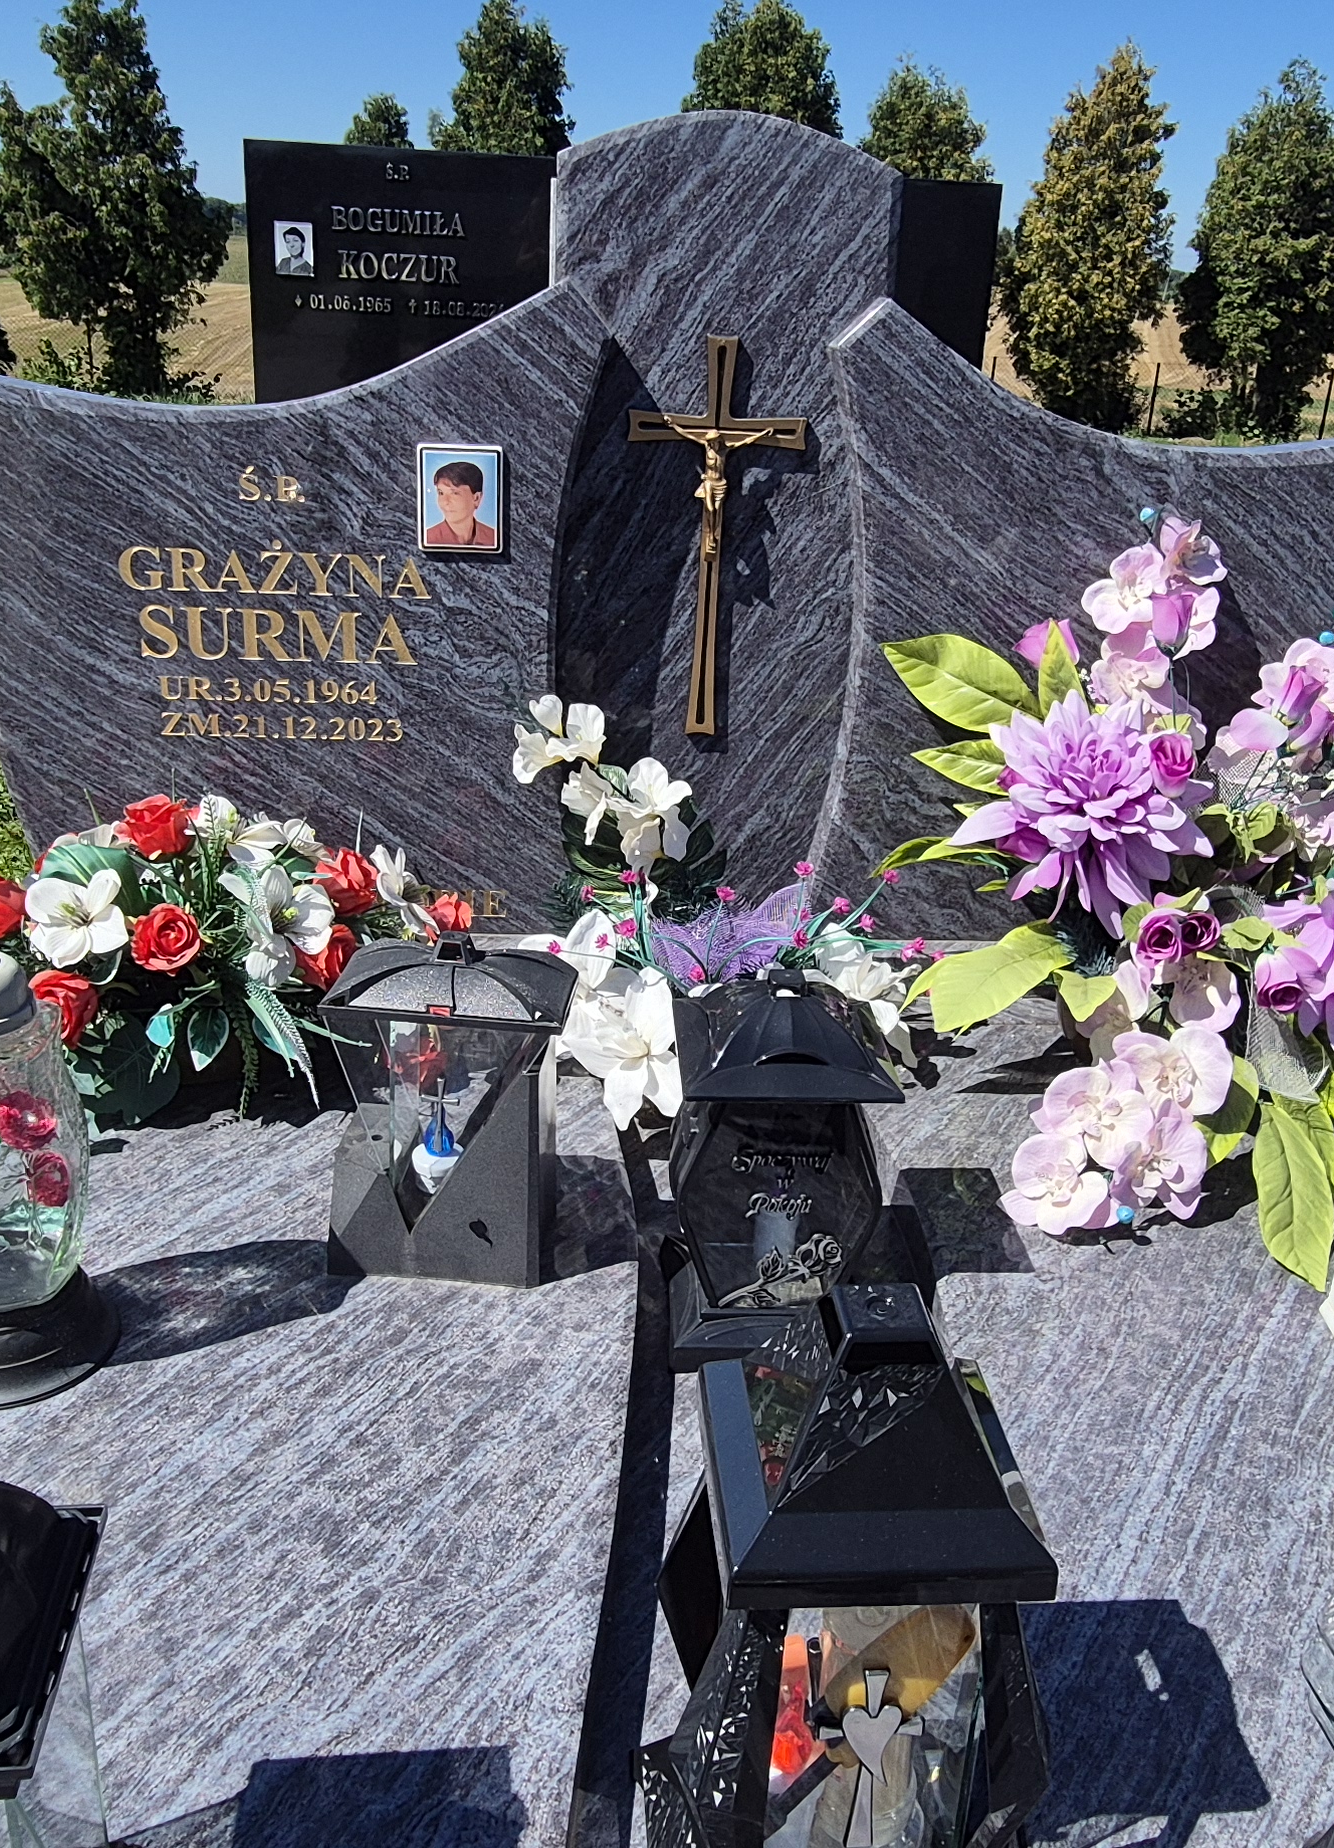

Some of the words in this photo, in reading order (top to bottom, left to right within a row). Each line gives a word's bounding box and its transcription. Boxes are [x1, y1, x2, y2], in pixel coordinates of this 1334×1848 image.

[385, 162, 410, 180] Ś.P.
[330, 205, 465, 237] BOGUMIŁA
[338, 249, 460, 284] KOCZUR
[238, 465, 306, 503] Ś.P.
[117, 539, 432, 600] GRAŻYNA
[139, 603, 418, 666] SURMA
[158, 674, 378, 706] UR.3.05.1964
[159, 711, 404, 743] ZM.21.12.2023
[745, 1193, 812, 1220] Pokoju
